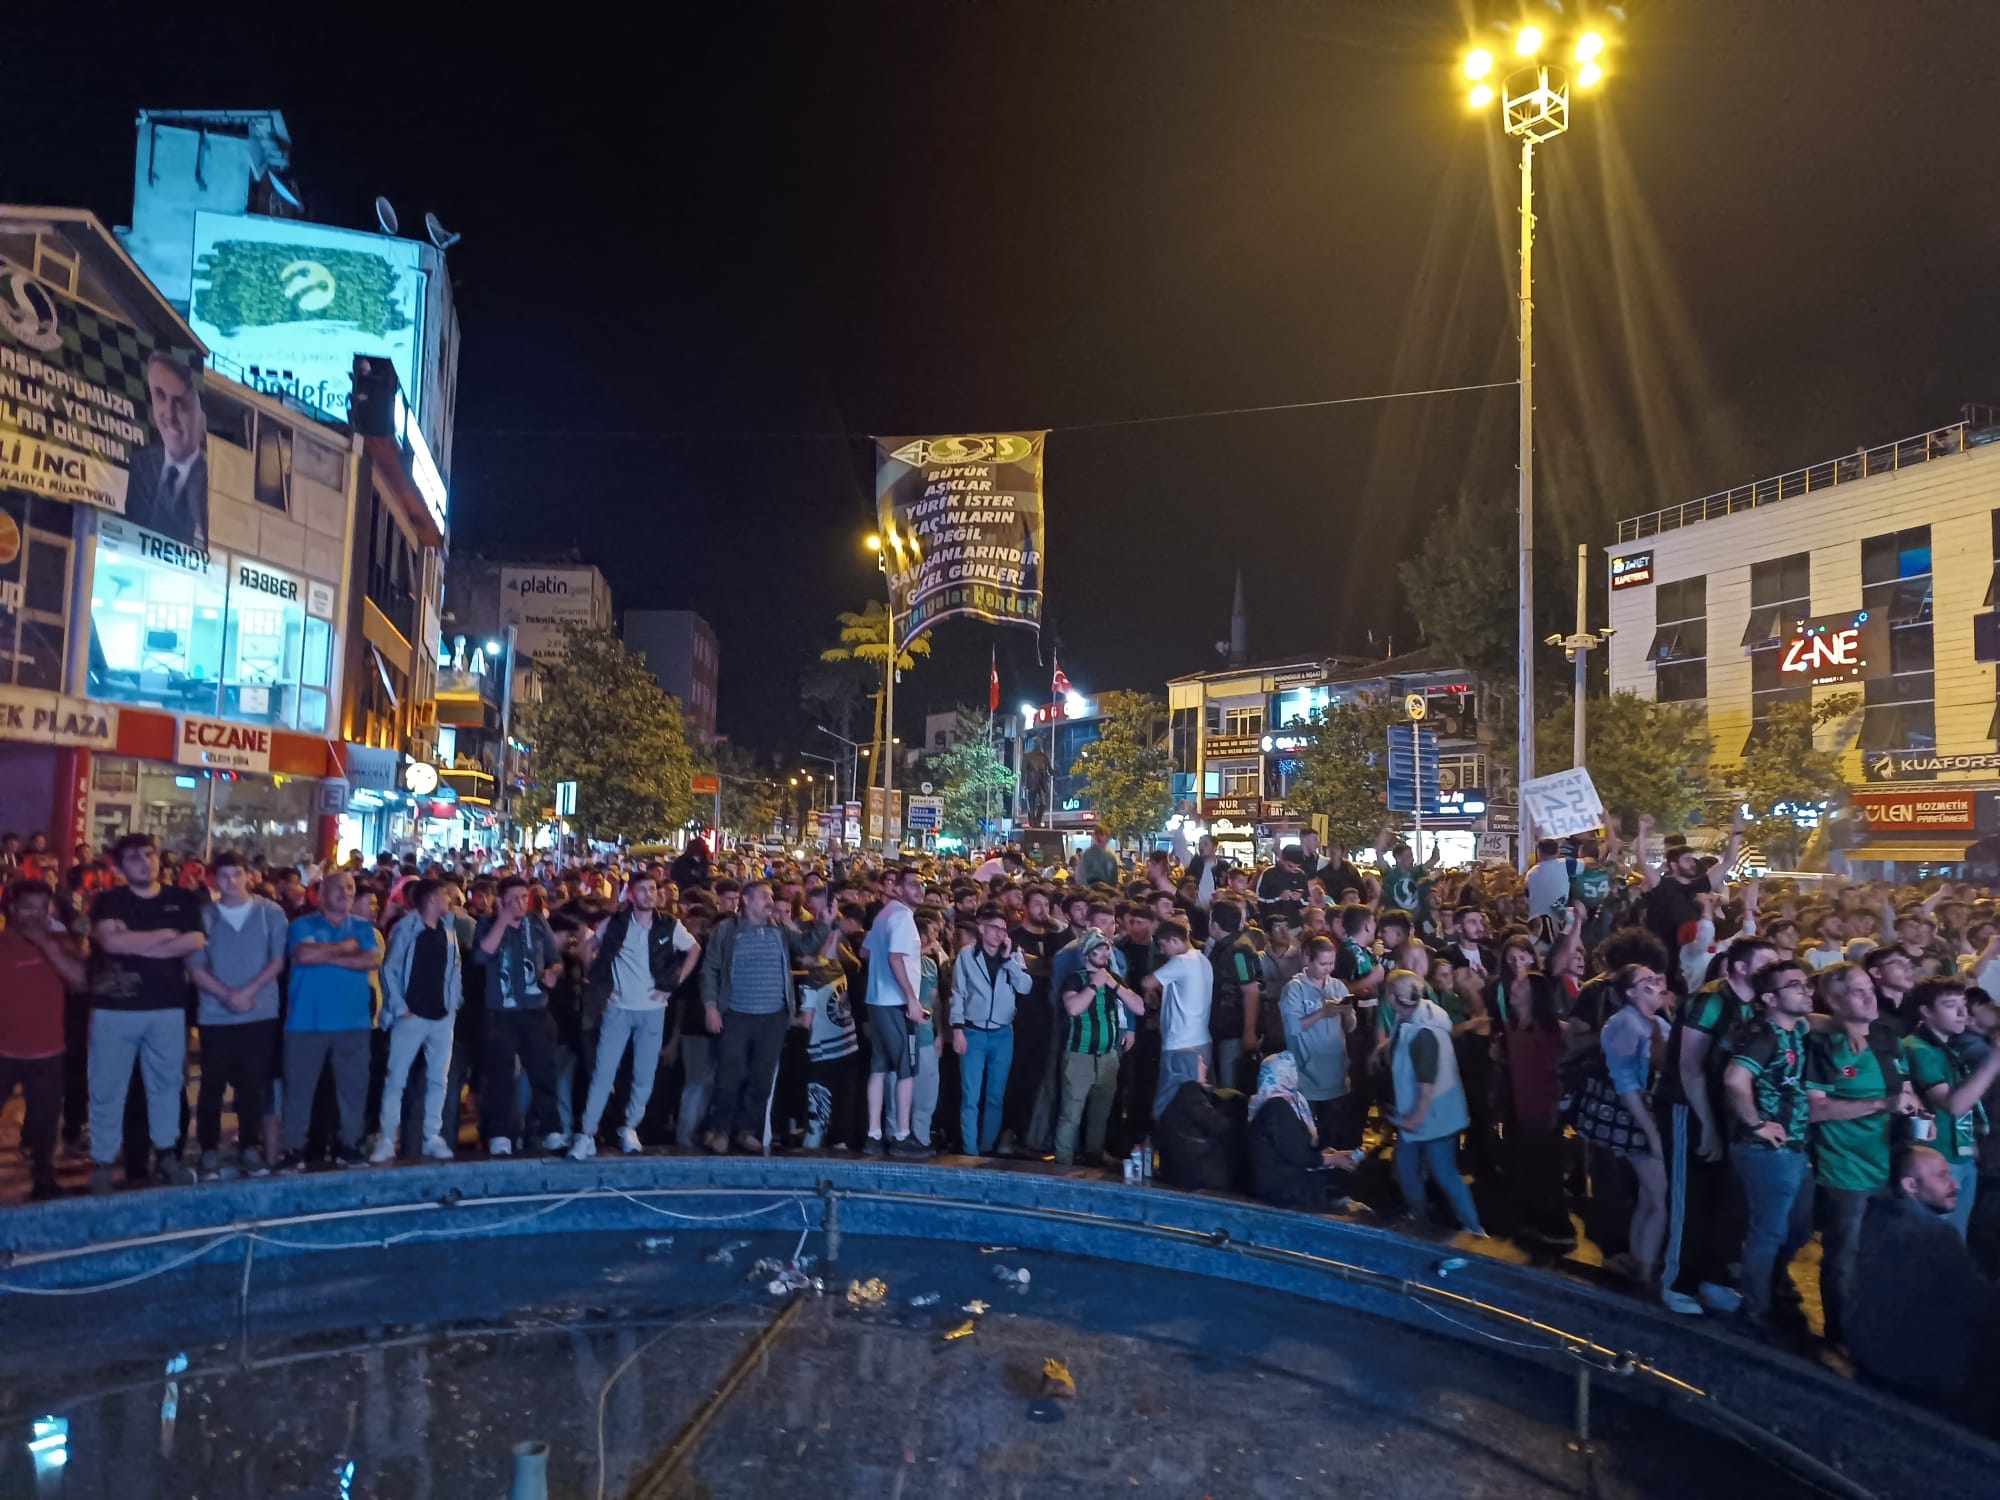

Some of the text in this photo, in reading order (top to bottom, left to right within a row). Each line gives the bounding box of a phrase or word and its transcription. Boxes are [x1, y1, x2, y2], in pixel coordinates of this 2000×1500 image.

[62, 397, 145, 447] YOLUNDA
[928, 465, 990, 482] BÜYÜK
[924, 480, 992, 498] AŞKLAR
[964, 491, 1015, 507] İSTER
[933, 526, 982, 547] DEĞİL
[139, 532, 210, 575] TRENDY
[948, 560, 1026, 586] GÜNLER!
[521, 575, 568, 598] platin
[33, 708, 108, 738] PLAZA
[184, 720, 268, 754] ECZANE
[1219, 801, 1239, 809] NUR
